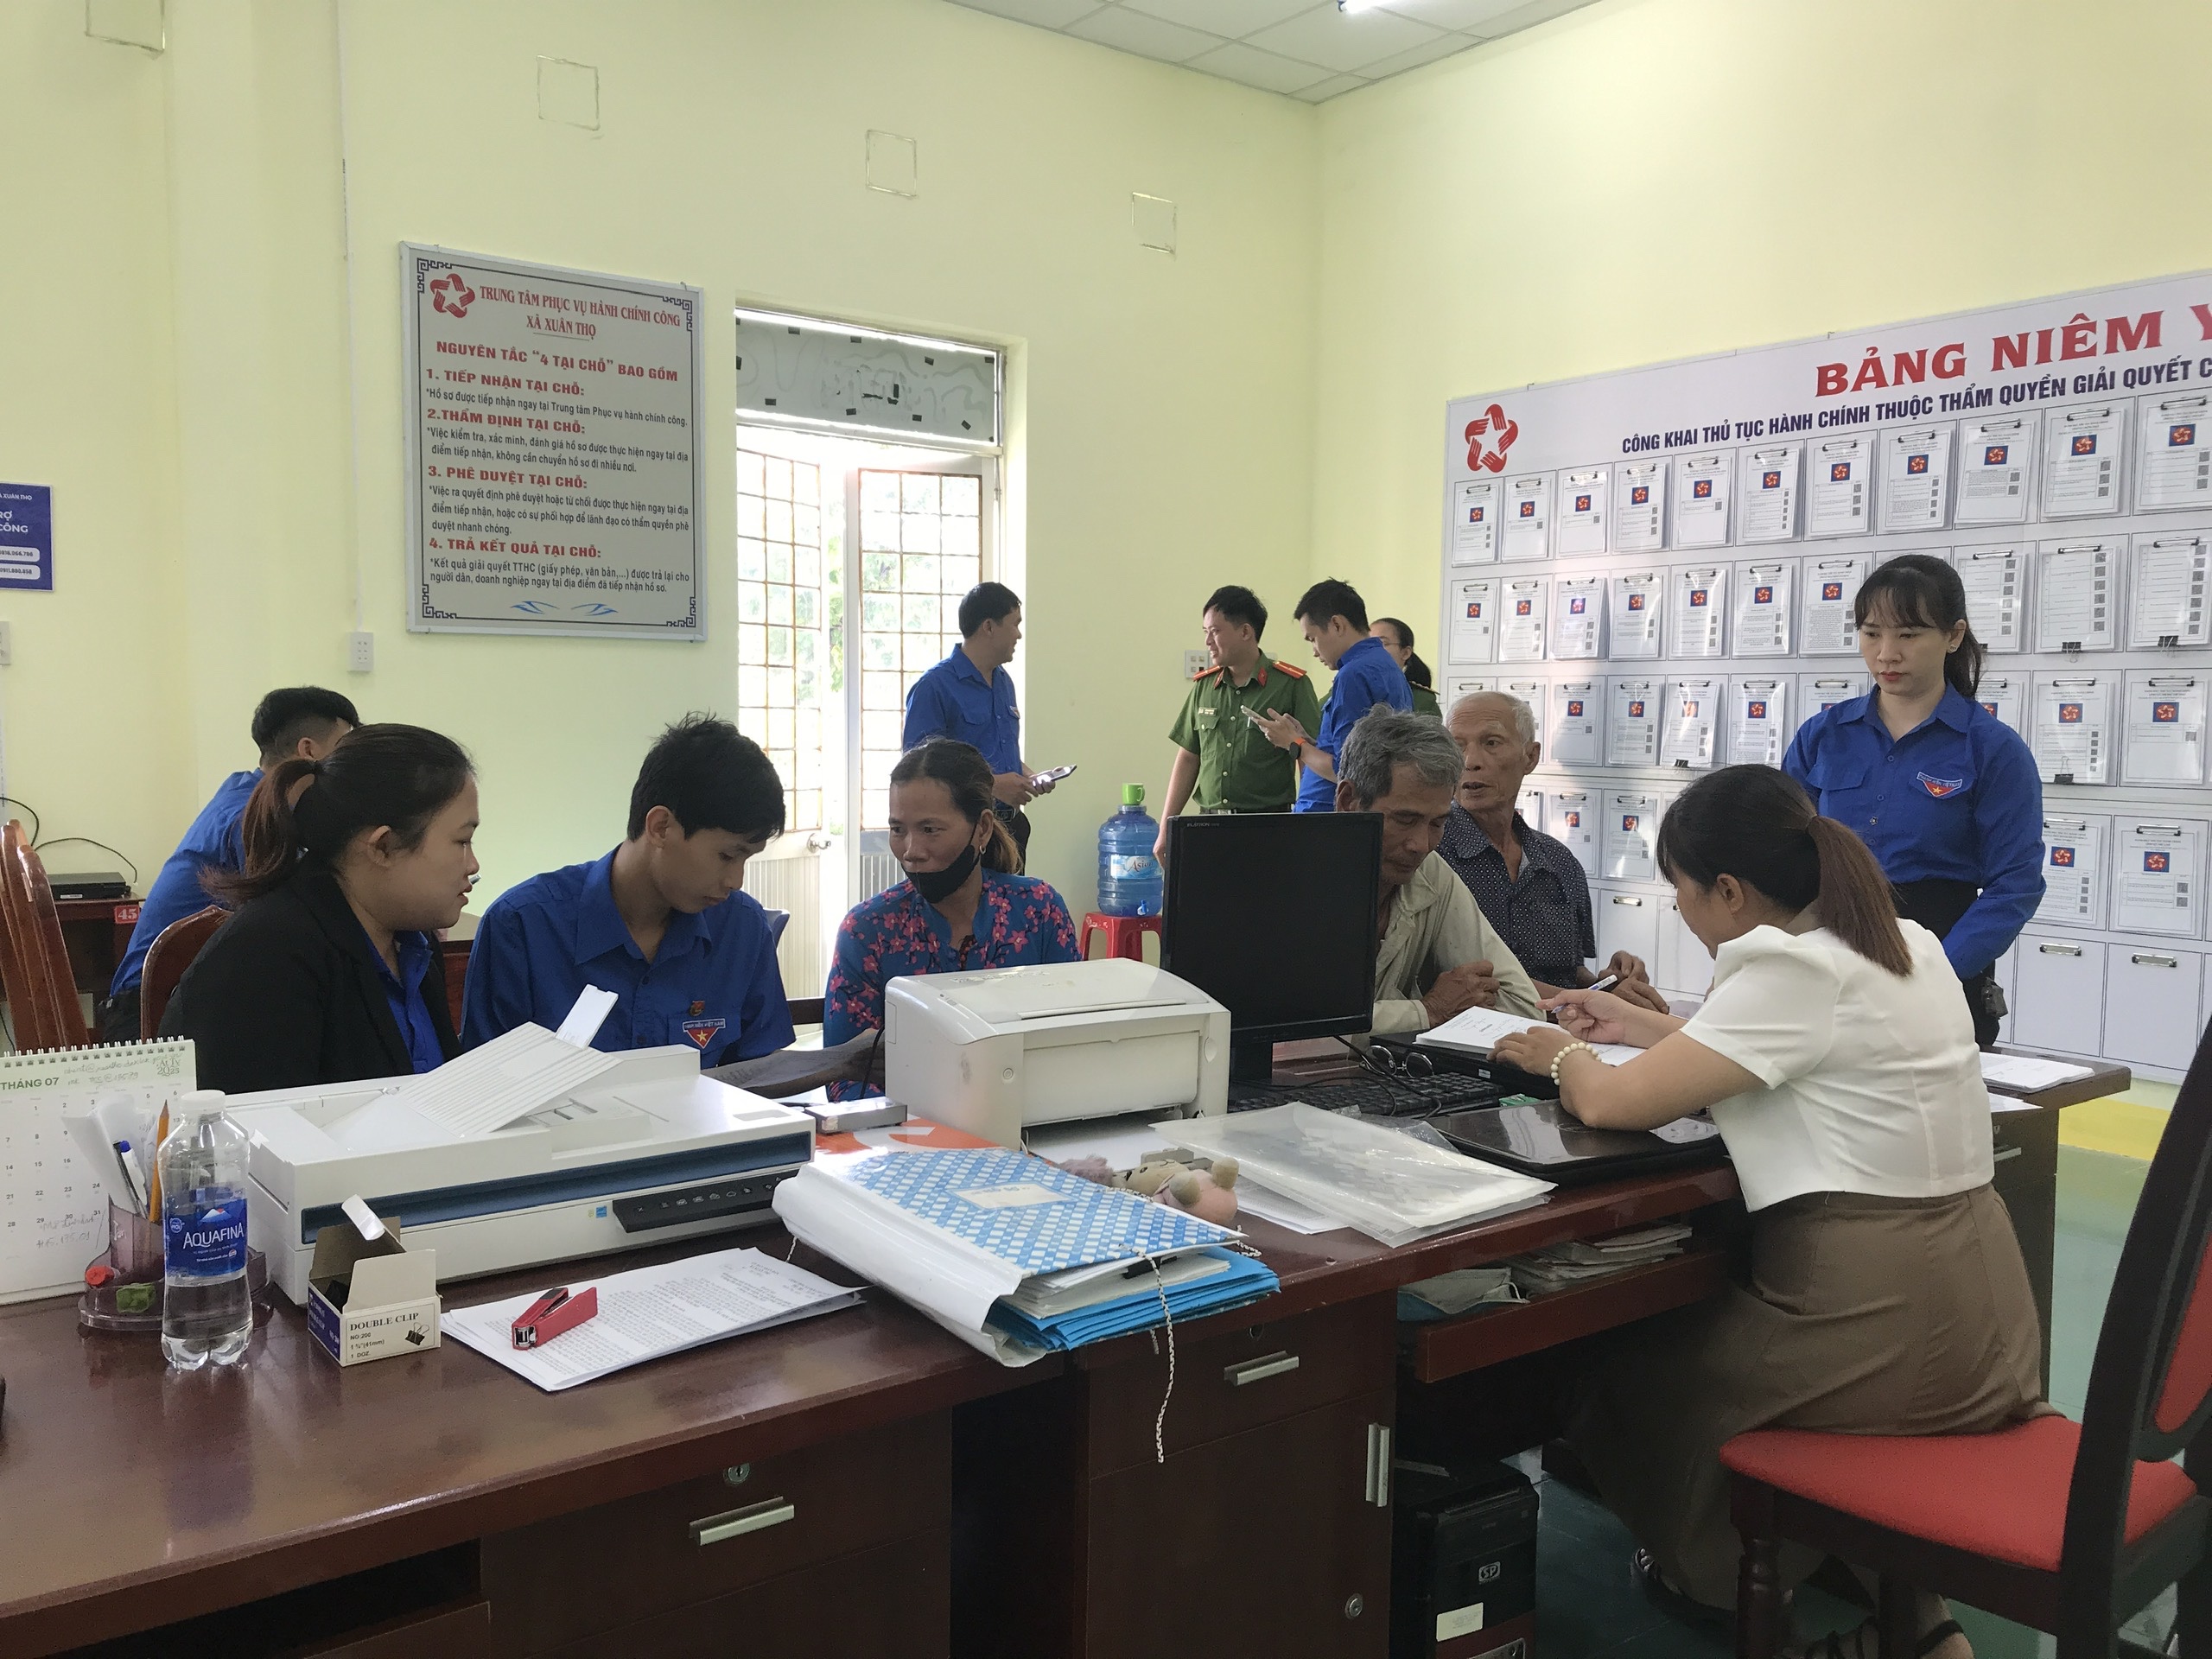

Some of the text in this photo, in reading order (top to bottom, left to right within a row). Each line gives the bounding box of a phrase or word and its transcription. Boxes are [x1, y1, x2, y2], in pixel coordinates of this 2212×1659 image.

[480, 285, 680, 327] TRUNG TÂM PHỤC VỤ HÀNH CHÍNH CÔNG
[544, 317, 573, 334] XUÂN
[575, 321, 596, 340] THỌ
[436, 340, 496, 359] NGUYÊN
[500, 346, 527, 363] TẮC
[552, 355, 574, 370] TẠI
[618, 364, 645, 378] BAO
[1815, 341, 1967, 397] BẢNG
[1991, 310, 2164, 372] NIÊM
[426, 368, 584, 396] 1. TIẾP NHẬN TẠI CHỖ:
[442, 391, 454, 401] sơ
[454, 391, 475, 404] được
[477, 392, 493, 406] tiếp
[495, 396, 516, 408] nhận
[518, 400, 537, 411] ngay
[538, 400, 550, 411] tại
[550, 401, 575, 416] Trung
[575, 404, 590, 415] tâm
[592, 406, 612, 418] Phục
[613, 410, 623, 420] vụ
[624, 410, 643, 421] hành
[645, 412, 665, 423] chính
[667, 415, 688, 428] công.
[1622, 433, 1660, 454] CÔNG
[1665, 428, 1698, 448] KHAI
[1703, 418, 1731, 443] THỦ
[1735, 419, 1764, 442] TỤC
[1770, 411, 1813, 435] HÀNH
[1818, 404, 1870, 428] CHÍNH
[1876, 395, 1933, 421] THUỘC
[1940, 383, 1993, 412] THẨM
[1999, 373, 2066, 406] QUYỀN
[2074, 365, 2115, 395] GIẢI
[2123, 355, 2192, 389] QUYẾT
[428, 408, 585, 434] 2.THẨM ĐỊNH TẠI CHỖ:
[431, 442, 637, 472] điểm tiếp nhận, không cần chuyển hồ sơ đi nhiều nơi.
[450, 428, 470, 440] kiểm
[472, 431, 486, 443] tra,
[488, 432, 503, 443] xác
[505, 435, 527, 447] minh,
[529, 436, 550, 448] đánh
[551, 439, 563, 451] giá
[565, 439, 576, 450] hồ
[588, 442, 607, 454] được
[608, 444, 626, 456] thực
[627, 446, 645, 458] hiện
[645, 450, 664, 461] ngay
[665, 450, 676, 461] tại
[677, 451, 689, 462] địa
[428, 465, 587, 488] 3. PHÊ DUYỆT TẠI CHỖ:
[451, 488, 460, 497] ra
[461, 487, 484, 500] quyết
[486, 489, 504, 501] định
[505, 491, 520, 502] phê
[522, 492, 543, 505] duyệt
[545, 493, 564, 506] hoặc
[565, 495, 574, 505] từ
[575, 495, 591, 507] chối
[592, 498, 611, 510] được
[613, 499, 629, 512] thực
[630, 500, 646, 512] hiện
[647, 504, 665, 515] ngay
[666, 505, 676, 515] tại
[677, 505, 688, 517] địa
[429, 536, 601, 558] 4. TRẢ KẾT QUẢ TẠI CHỖ:
[450, 557, 467, 570] quả
[468, 558, 485, 572] giải
[486, 560, 511, 573] quyết
[512, 562, 536, 573] TTHC
[537, 563, 558, 576] (giấy
[560, 565, 583, 577] phép,
[585, 566, 600, 578] văn
[631, 569, 650, 581] được
[652, 569, 662, 580] trả
[664, 570, 673, 582] lại
[675, 571, 690, 582] cho
[118, 907, 139, 921] 45
[1, 1078, 42, 1091] THÁNG
[45, 1077, 60, 1087] 07
[182, 1222, 245, 1249] AQUAFINA
[350, 1313, 419, 1332] DOUBLE CLIP
